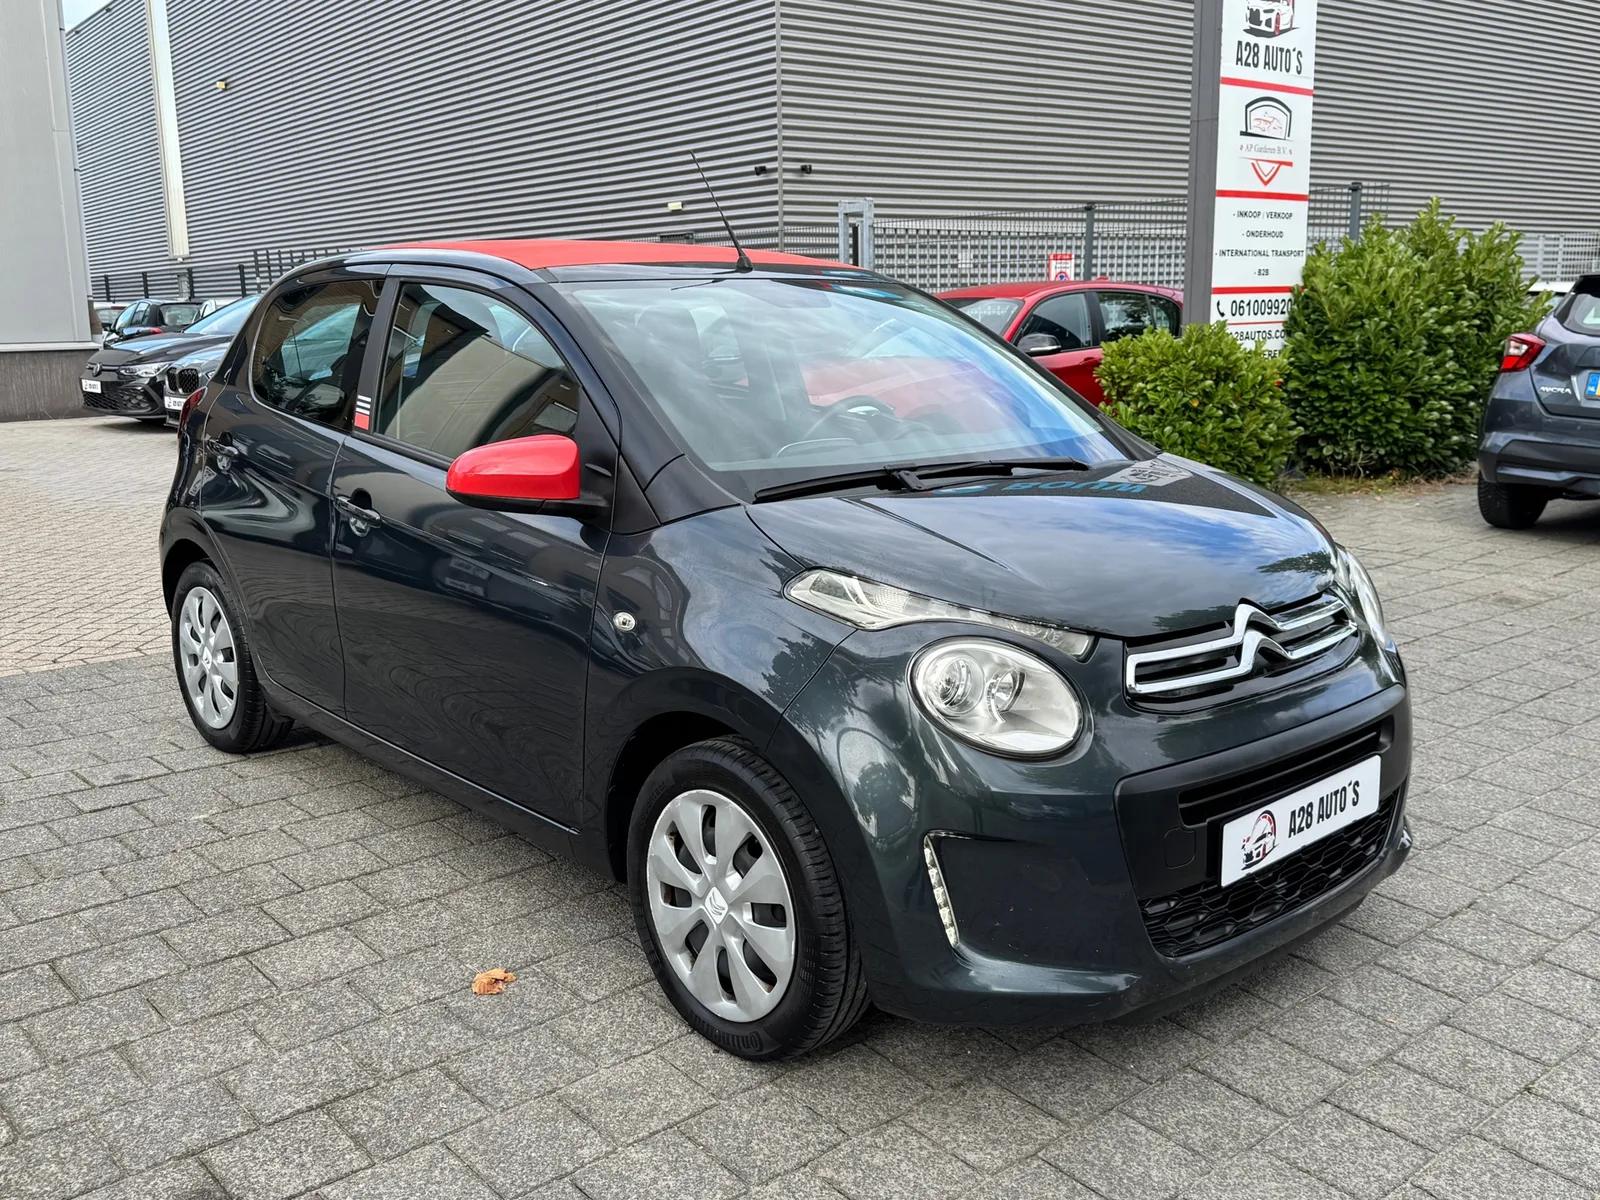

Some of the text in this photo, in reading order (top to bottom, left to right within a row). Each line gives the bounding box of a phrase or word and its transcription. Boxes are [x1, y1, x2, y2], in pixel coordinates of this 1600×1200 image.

[1236, 40, 1259, 68] A28
[1237, 211, 1261, 219] INKOOP
[1266, 212, 1293, 220] VERKOOP
[1246, 230, 1284, 238] ONDERHOUD
[1219, 249, 1269, 257] INTERNATIONAL
[1271, 249, 1304, 257] TRANSPORT
[1230, 329, 1288, 341] 28AUTOS.CO
[1540, 386, 1572, 394] MICRA
[1288, 801, 1313, 838] A28
